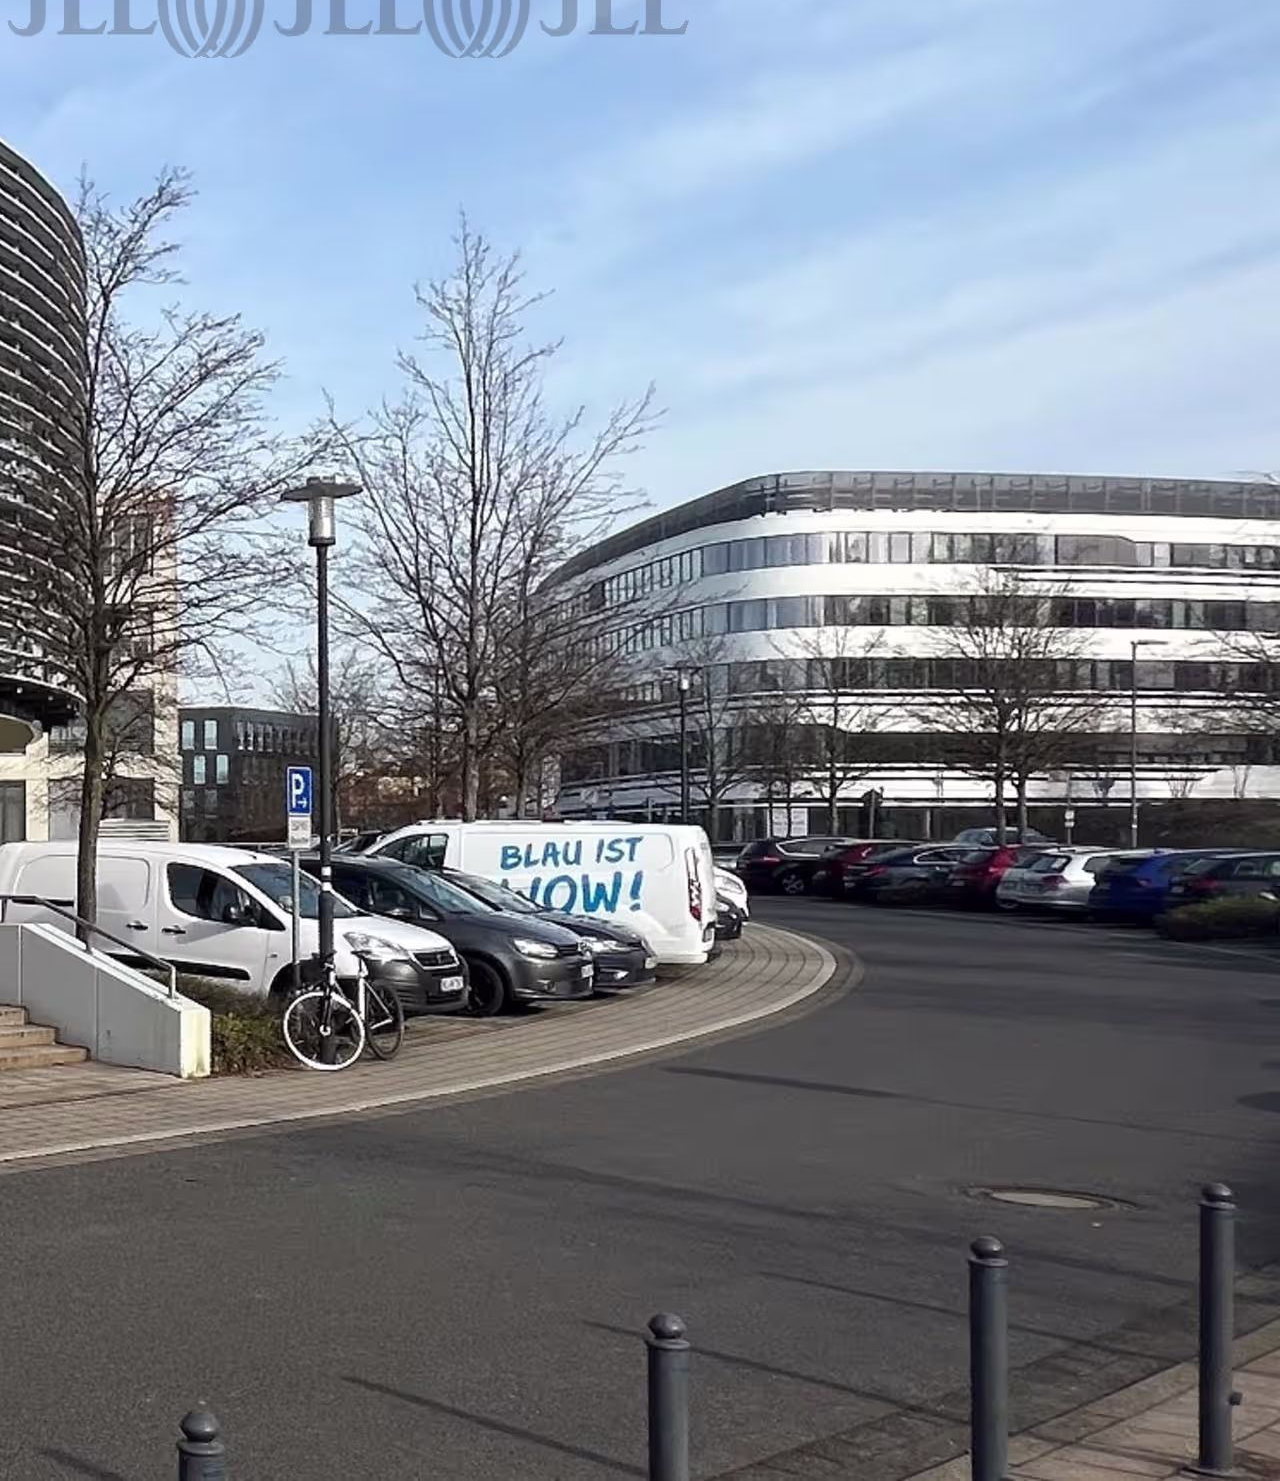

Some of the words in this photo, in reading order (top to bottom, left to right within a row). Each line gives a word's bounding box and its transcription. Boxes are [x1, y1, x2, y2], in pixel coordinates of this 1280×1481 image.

[292, 772, 305, 809] P
[500, 839, 583, 870] BLAU
[596, 835, 644, 863] IST
